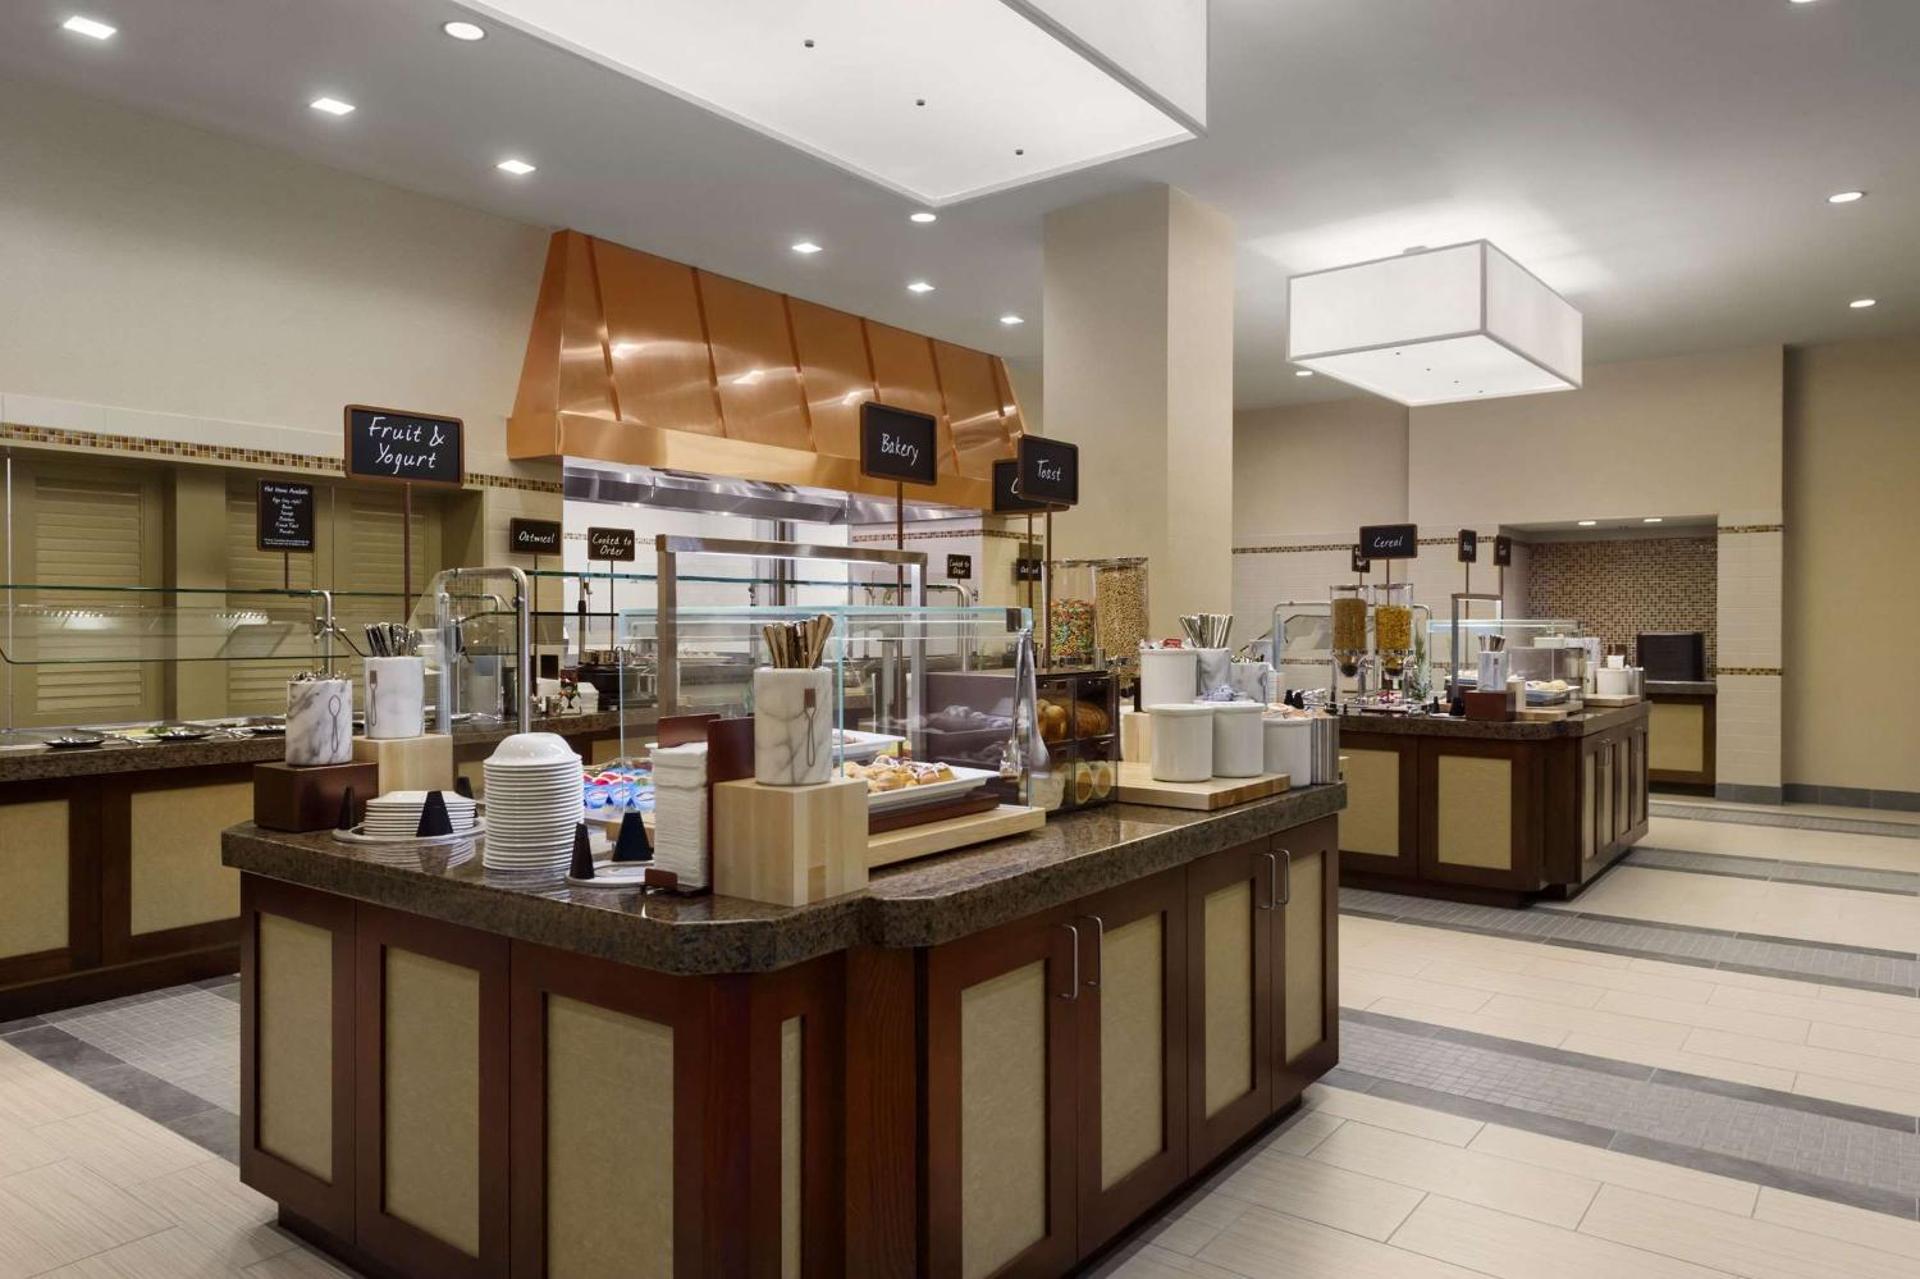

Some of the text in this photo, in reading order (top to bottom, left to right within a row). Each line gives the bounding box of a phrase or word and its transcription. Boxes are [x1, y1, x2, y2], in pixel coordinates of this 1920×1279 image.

[368, 416, 445, 447] Fruit &
[375, 442, 437, 475] Yogurt
[881, 432, 919, 467] Bakery
[1036, 458, 1061, 482] Toast
[518, 530, 556, 544] Oatmeal
[592, 532, 633, 547] Cooked to
[1373, 535, 1404, 548] Cereal
[599, 545, 625, 556] Order
